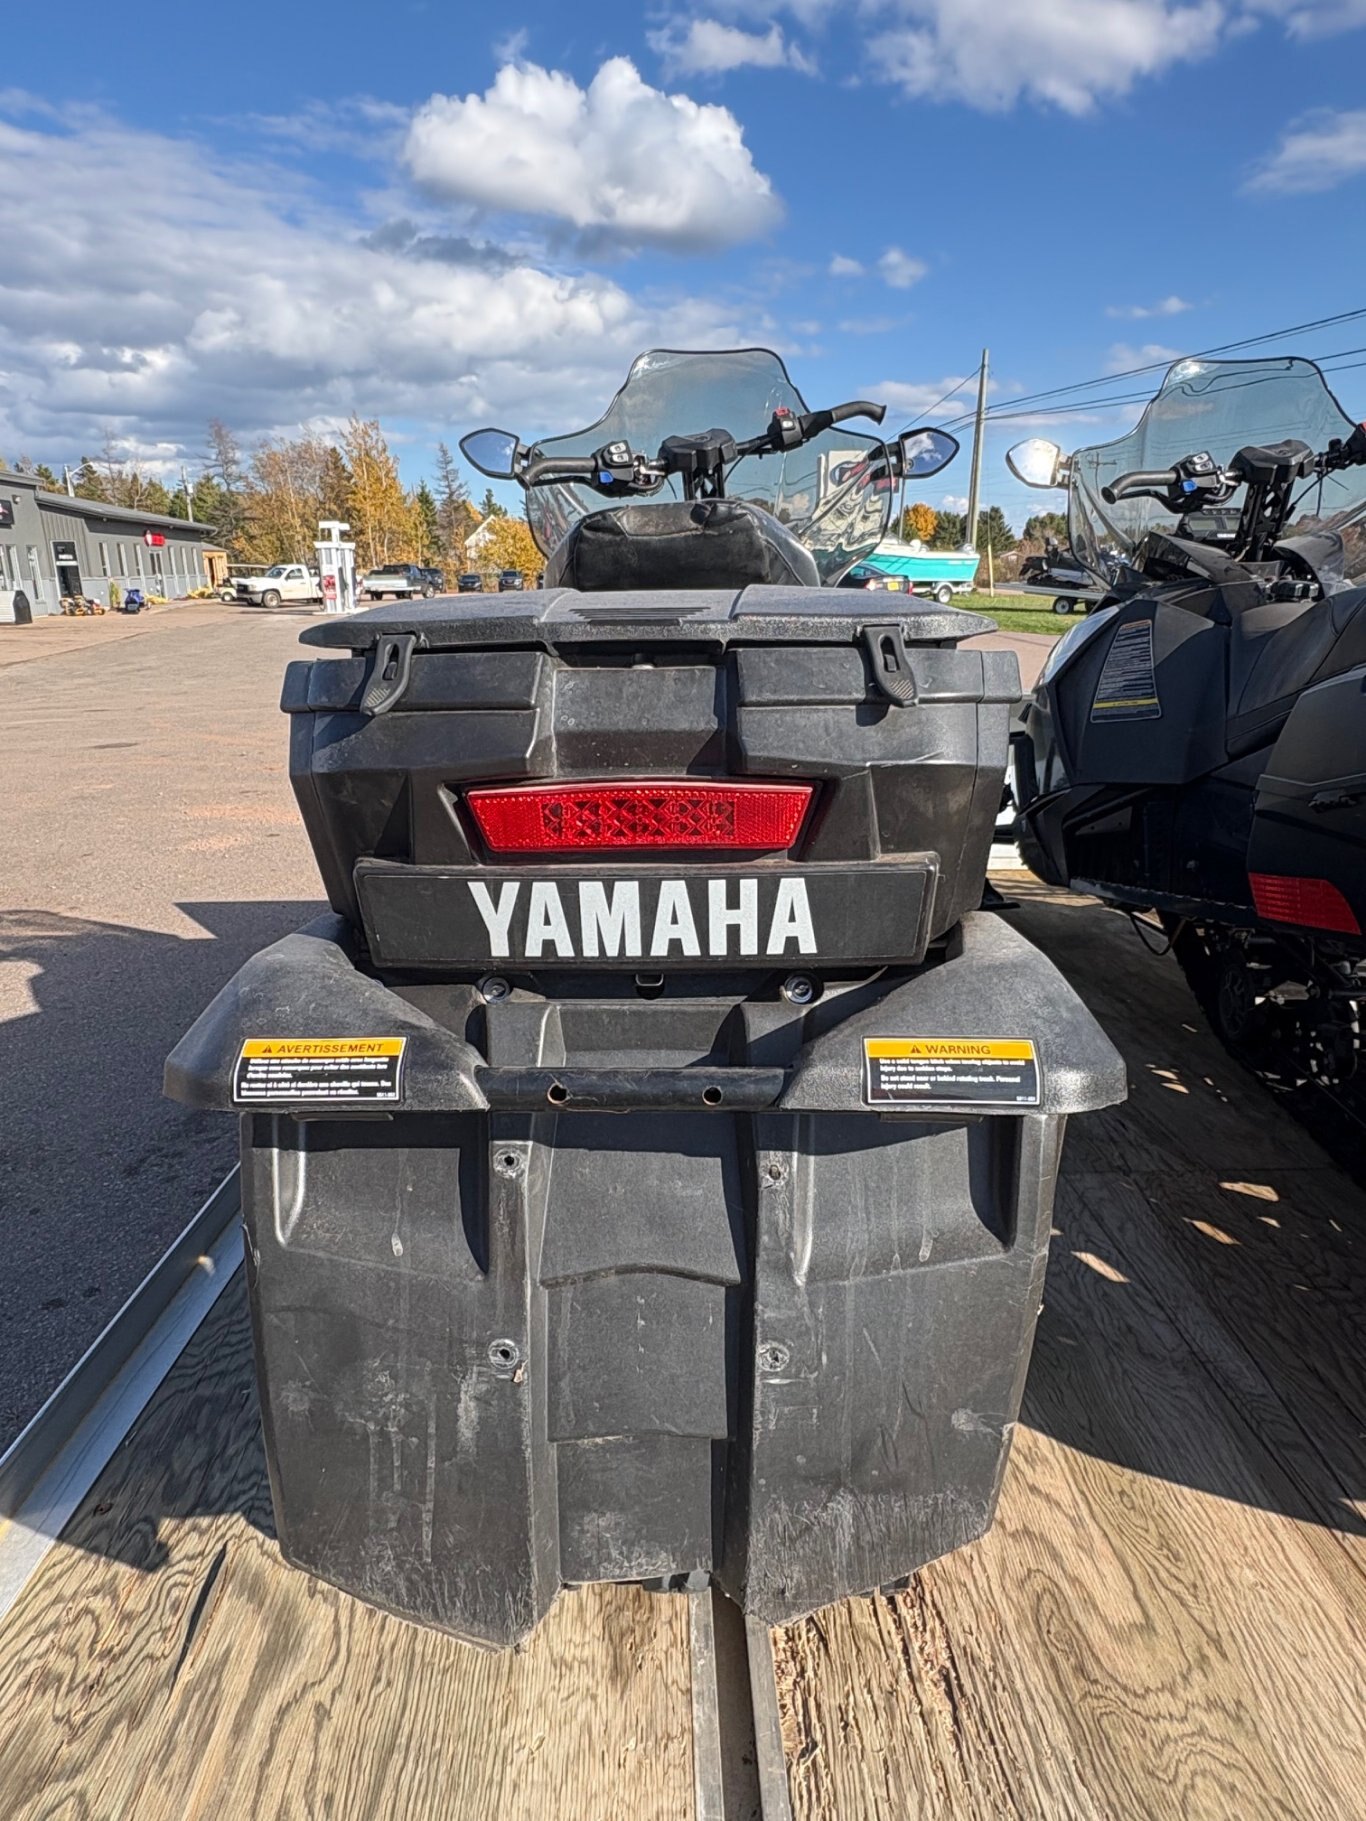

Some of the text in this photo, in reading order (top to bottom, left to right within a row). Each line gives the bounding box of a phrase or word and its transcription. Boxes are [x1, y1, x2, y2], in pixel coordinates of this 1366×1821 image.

[467, 878, 818, 957] YAMAHA
[277, 1043, 385, 1054] AVERTISSEMENT
[925, 1044, 991, 1055] WARNING
